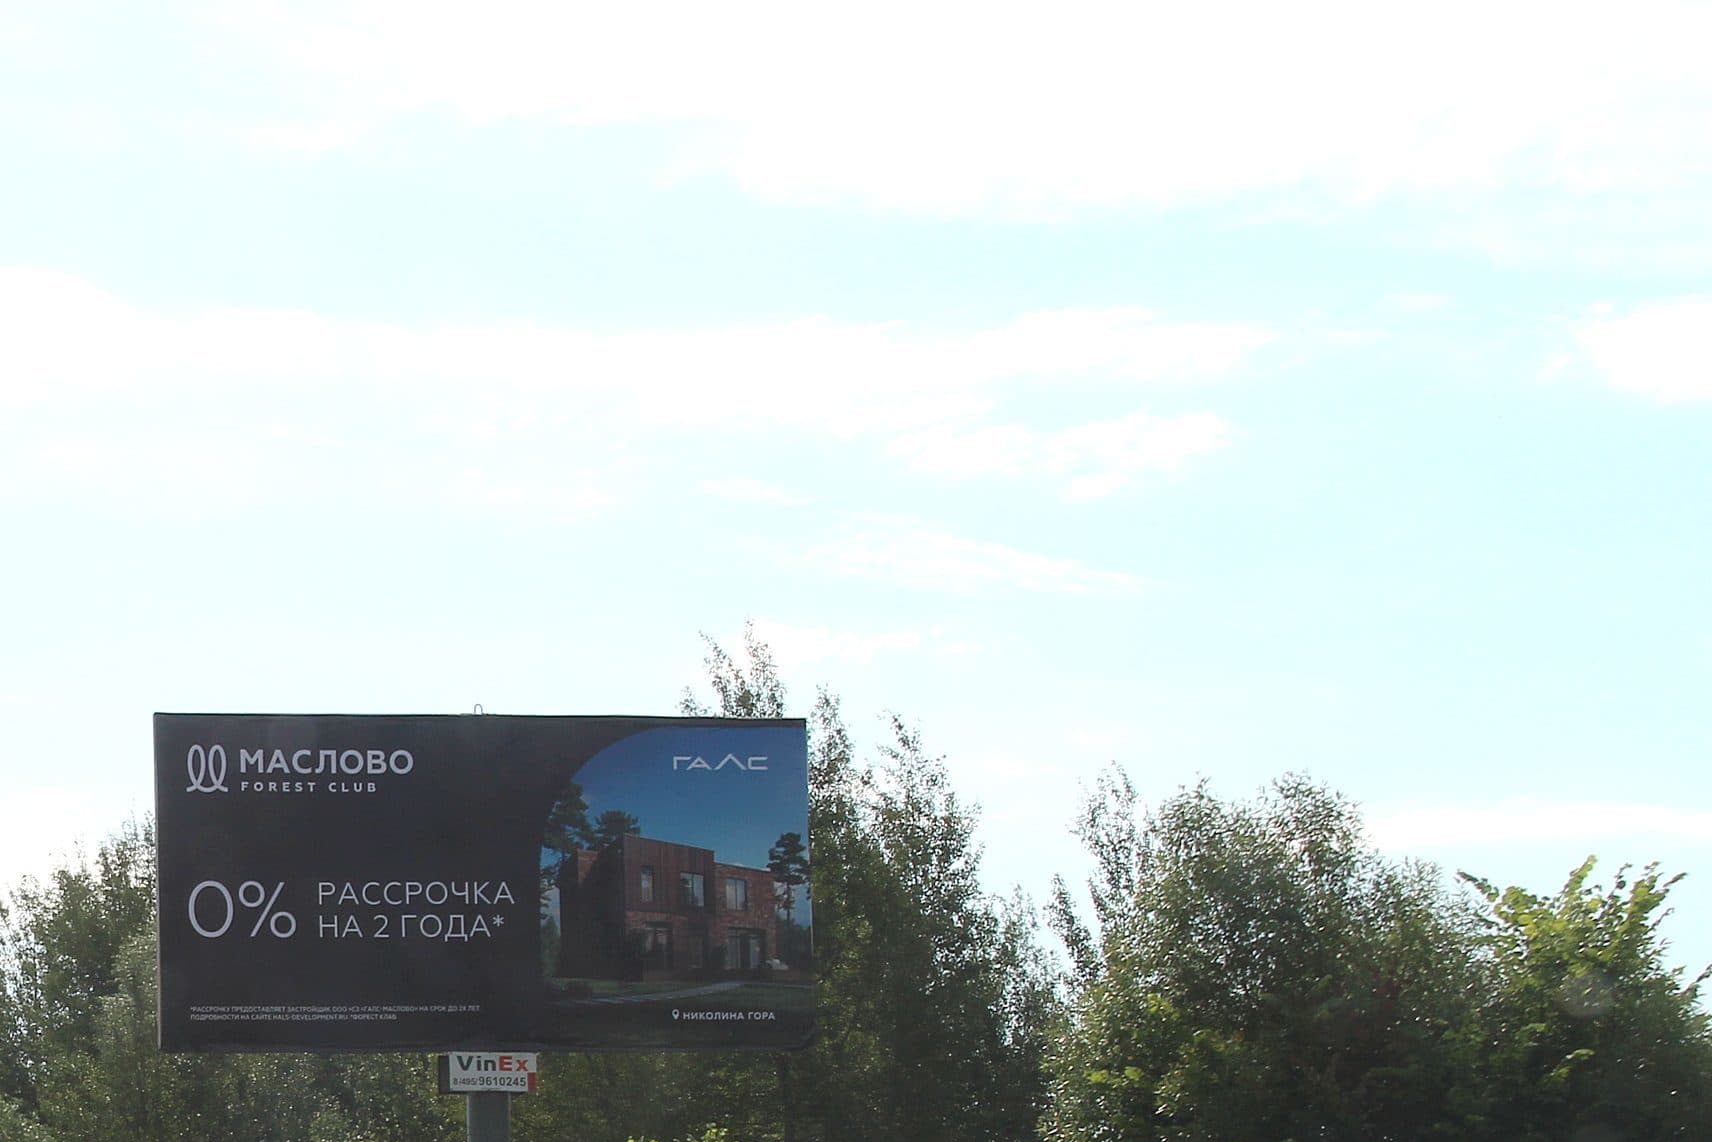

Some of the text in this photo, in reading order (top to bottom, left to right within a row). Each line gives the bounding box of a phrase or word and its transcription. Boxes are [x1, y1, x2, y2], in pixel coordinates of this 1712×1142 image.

[239, 748, 415, 775] МАСЛОВО
[240, 781, 377, 793] FOREST CLUB
[317, 880, 516, 906] РАССРОЧКА
[187, 879, 298, 939] 0%
[318, 914, 364, 939] НА
[372, 914, 391, 939] 2
[682, 1011, 776, 1020] НИКОЛИНА ГОРА
[455, 1055, 529, 1072] VinEx
